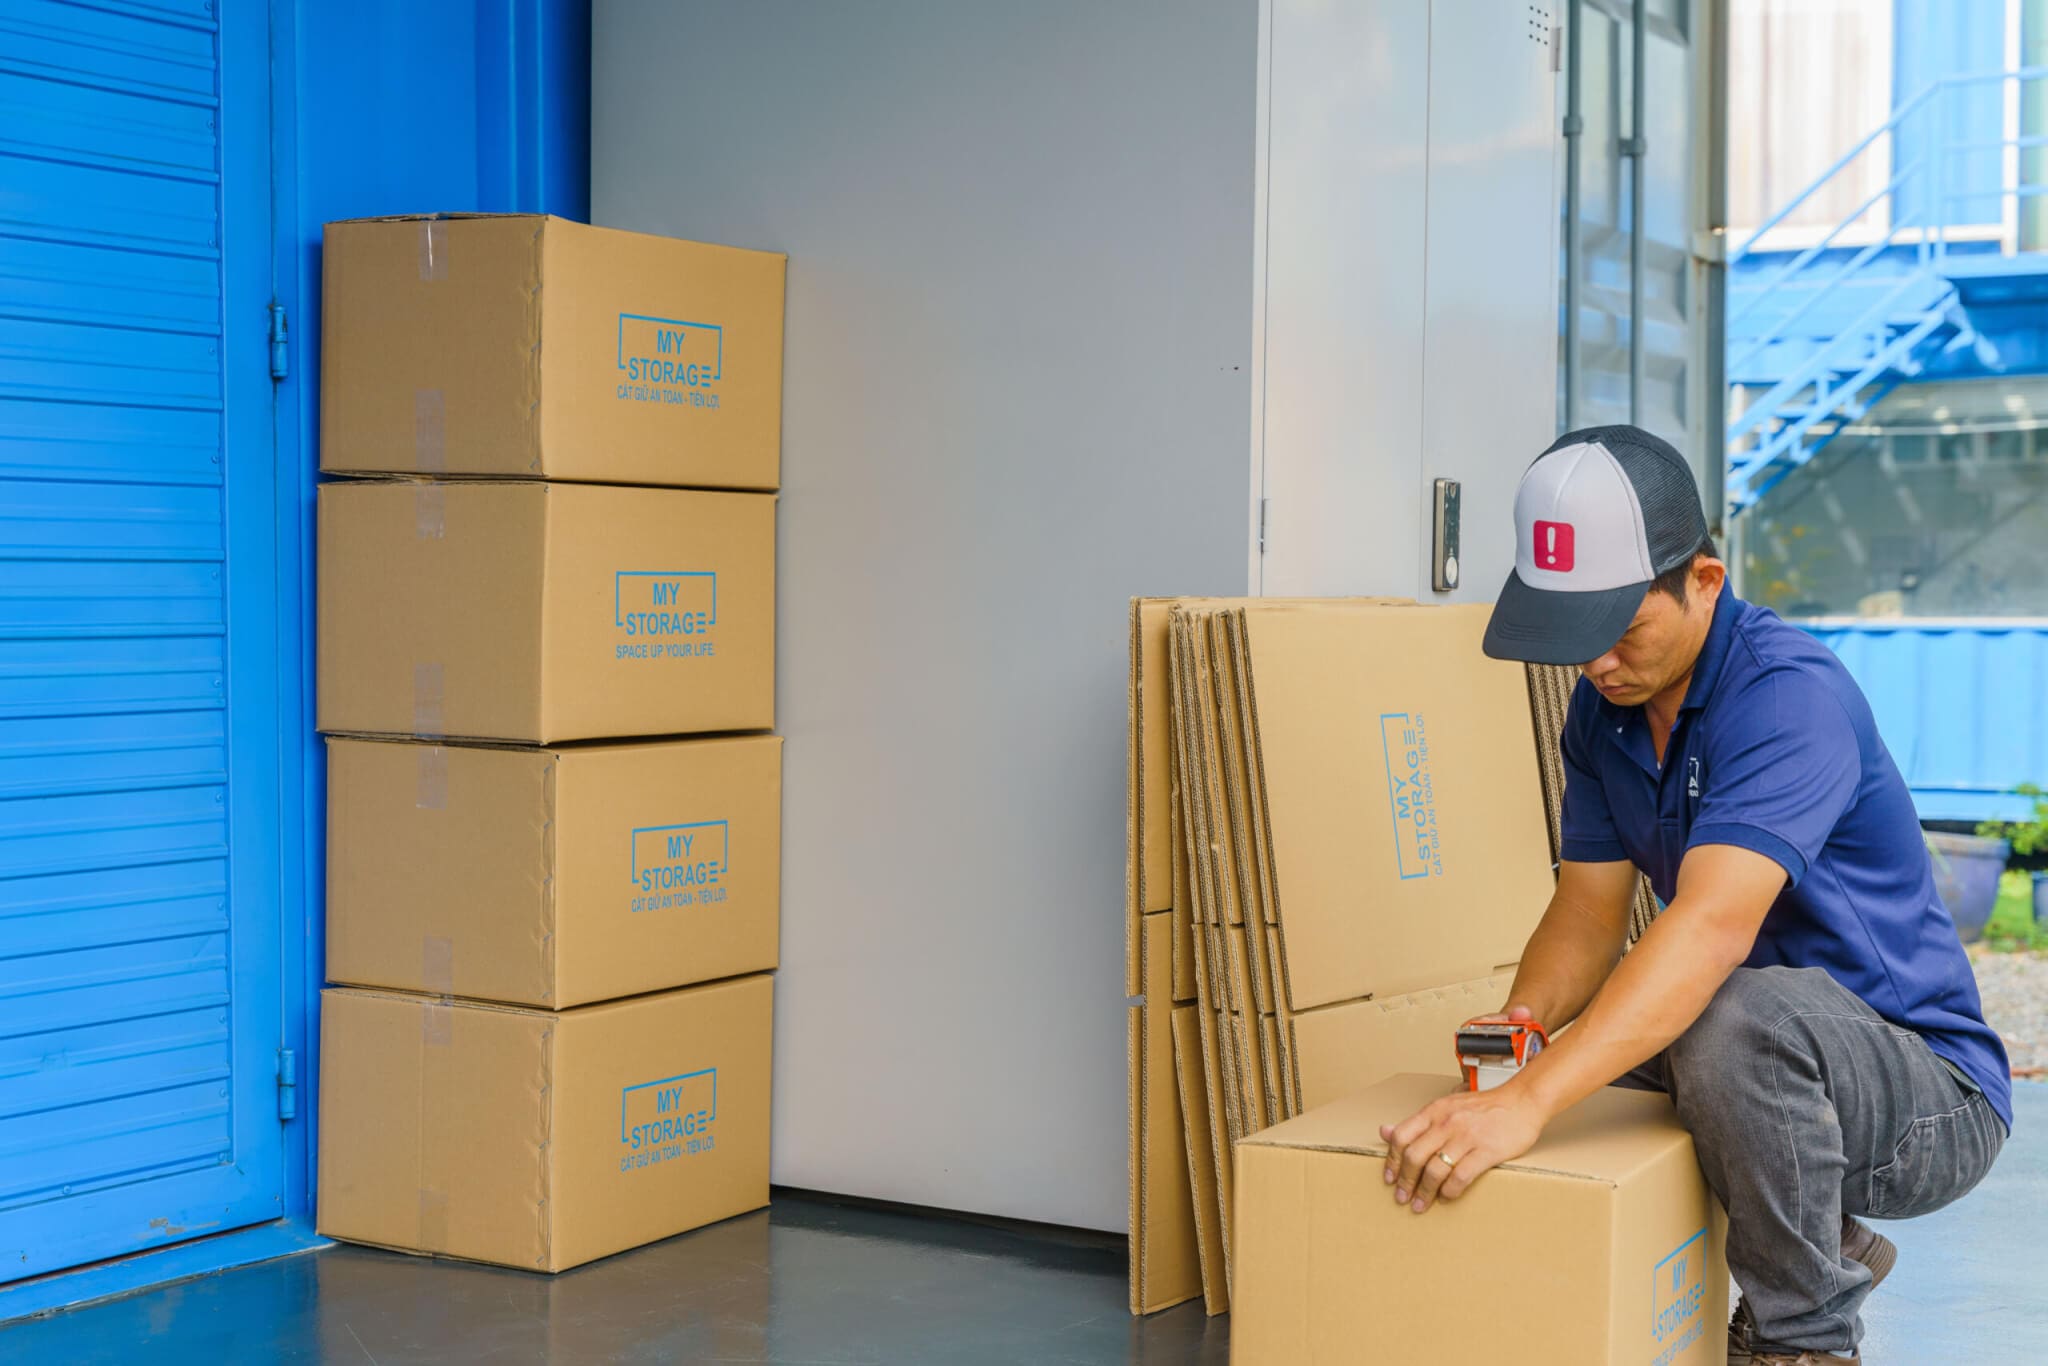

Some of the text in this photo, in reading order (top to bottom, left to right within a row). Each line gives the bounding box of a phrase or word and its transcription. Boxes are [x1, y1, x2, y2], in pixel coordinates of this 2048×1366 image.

[657, 329, 686, 355] MY
[628, 357, 711, 387] STORAGE
[650, 387, 661, 401] AN
[653, 582, 681, 606] MY
[626, 612, 706, 635] STORAGE
[616, 644, 648, 659] SPACE
[650, 643, 663, 658] UP
[666, 643, 692, 657] YOUR
[1393, 776, 1410, 818] MY
[1404, 729, 1430, 860] STORAGE
[1427, 808, 1437, 825] AN
[668, 834, 694, 859] MY
[642, 861, 718, 892] STORAGE
[662, 895, 672, 908] AN
[657, 1086, 683, 1114] MY
[631, 1110, 707, 1149] STORAGE
[1672, 1254, 1688, 1293] MY
[1658, 1281, 1701, 1343] STORAGE
